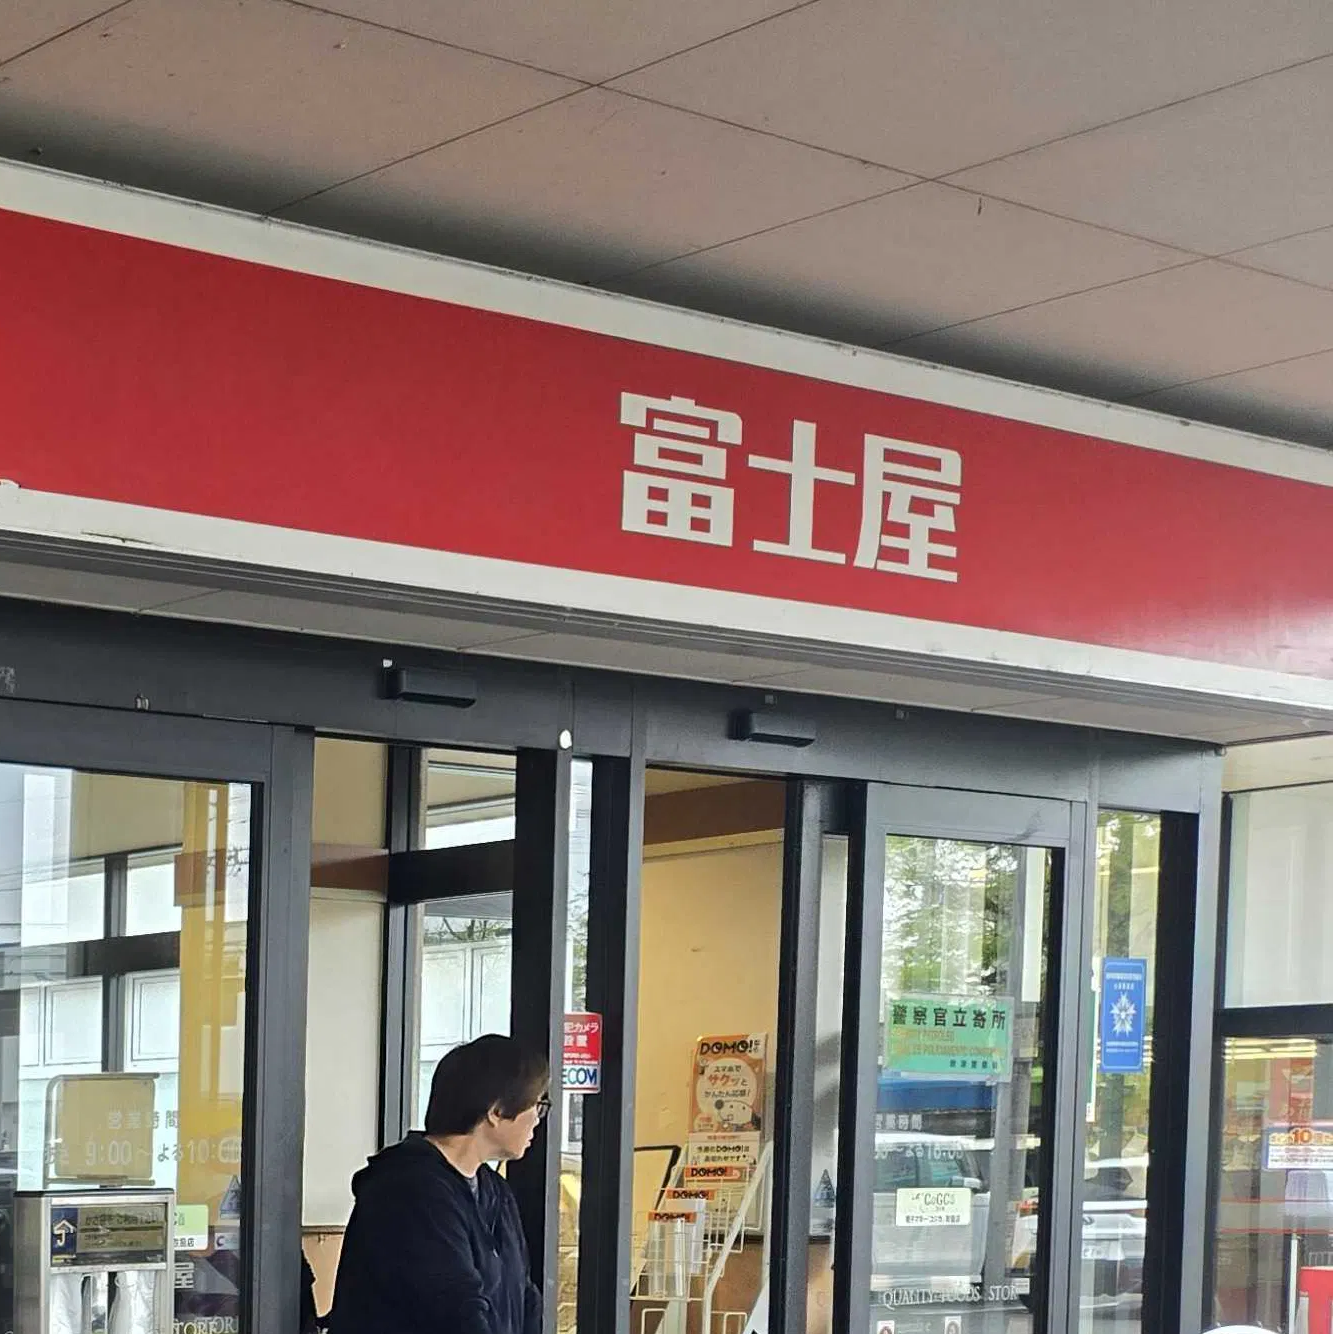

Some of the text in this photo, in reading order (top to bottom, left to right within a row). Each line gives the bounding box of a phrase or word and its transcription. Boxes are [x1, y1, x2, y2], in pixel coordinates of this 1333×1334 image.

[619, 391, 963, 583] 富士屋
[892, 1004, 1006, 1031] 警察官立寄所
[700, 1040, 753, 1055] DOMO!
